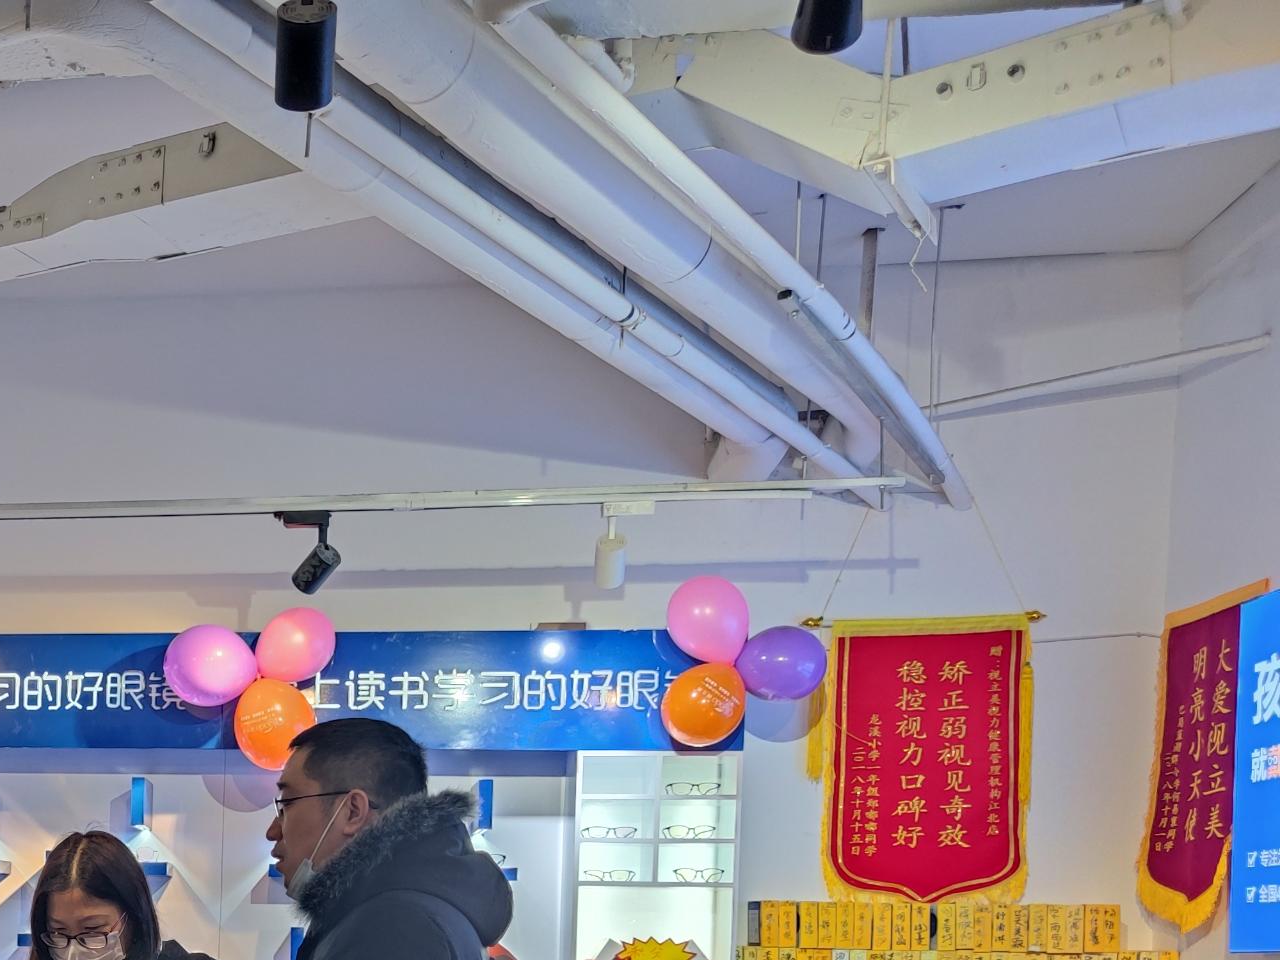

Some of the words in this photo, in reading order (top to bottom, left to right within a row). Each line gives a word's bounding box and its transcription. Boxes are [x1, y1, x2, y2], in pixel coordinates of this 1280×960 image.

[891, 660, 928, 849] 稳控视力口碑好
[937, 660, 973, 848] 矫正弱视见奇效
[1184, 645, 1208, 844] 明亮小天使
